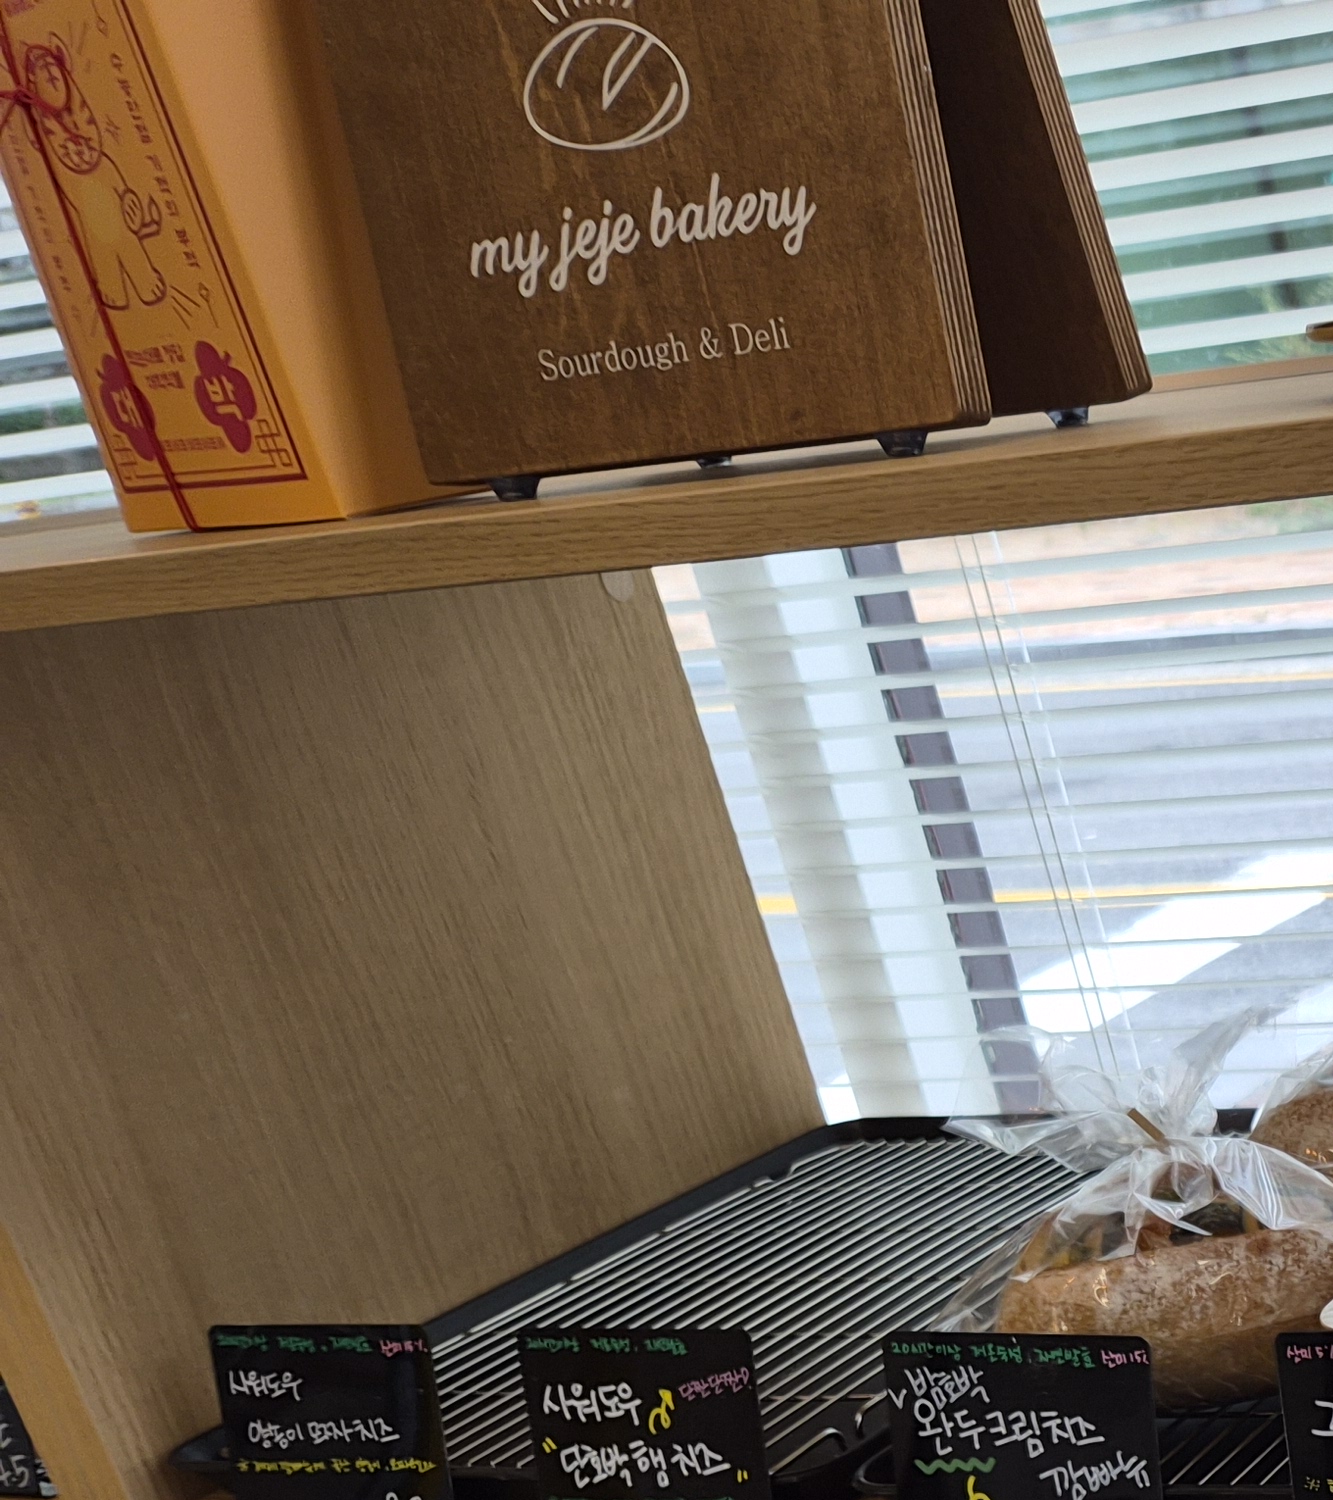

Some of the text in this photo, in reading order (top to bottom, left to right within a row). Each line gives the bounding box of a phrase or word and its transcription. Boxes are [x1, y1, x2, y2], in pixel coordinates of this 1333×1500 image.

[470, 172, 817, 298] my jeje bakery
[537, 316, 791, 381] Sourdough & Deli
[229, 1370, 303, 1401] 사워도우
[542, 1381, 643, 1426] 사워도우
